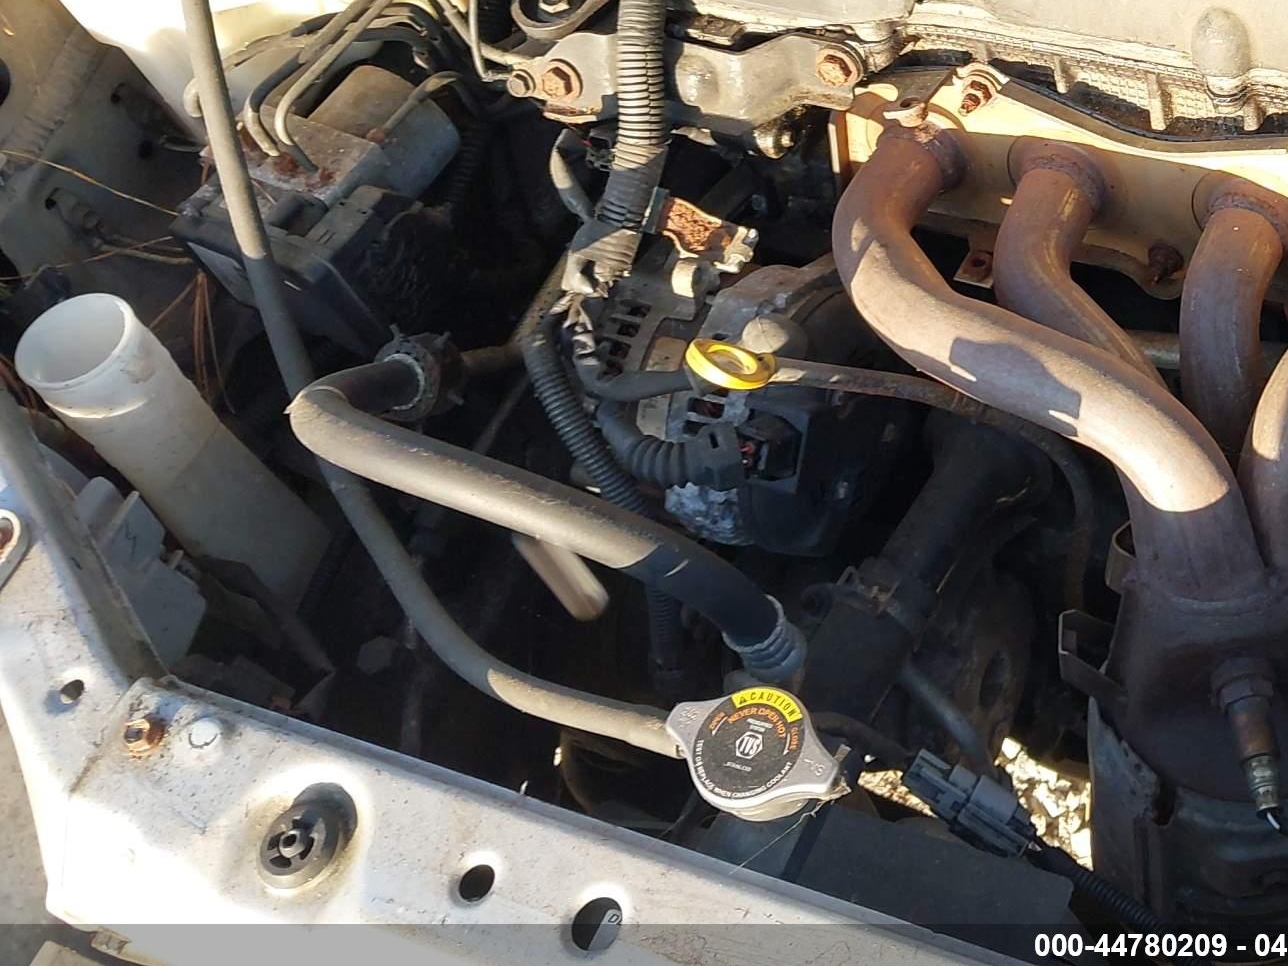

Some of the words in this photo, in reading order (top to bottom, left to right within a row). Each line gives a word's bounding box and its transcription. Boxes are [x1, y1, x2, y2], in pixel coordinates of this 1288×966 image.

[750, 691, 797, 718] CAUTION
[727, 707, 757, 724] NEVER
[758, 708, 778, 726] OPEN
[775, 719, 787, 739] HOT
[766, 761, 793, 788] COOLANT
